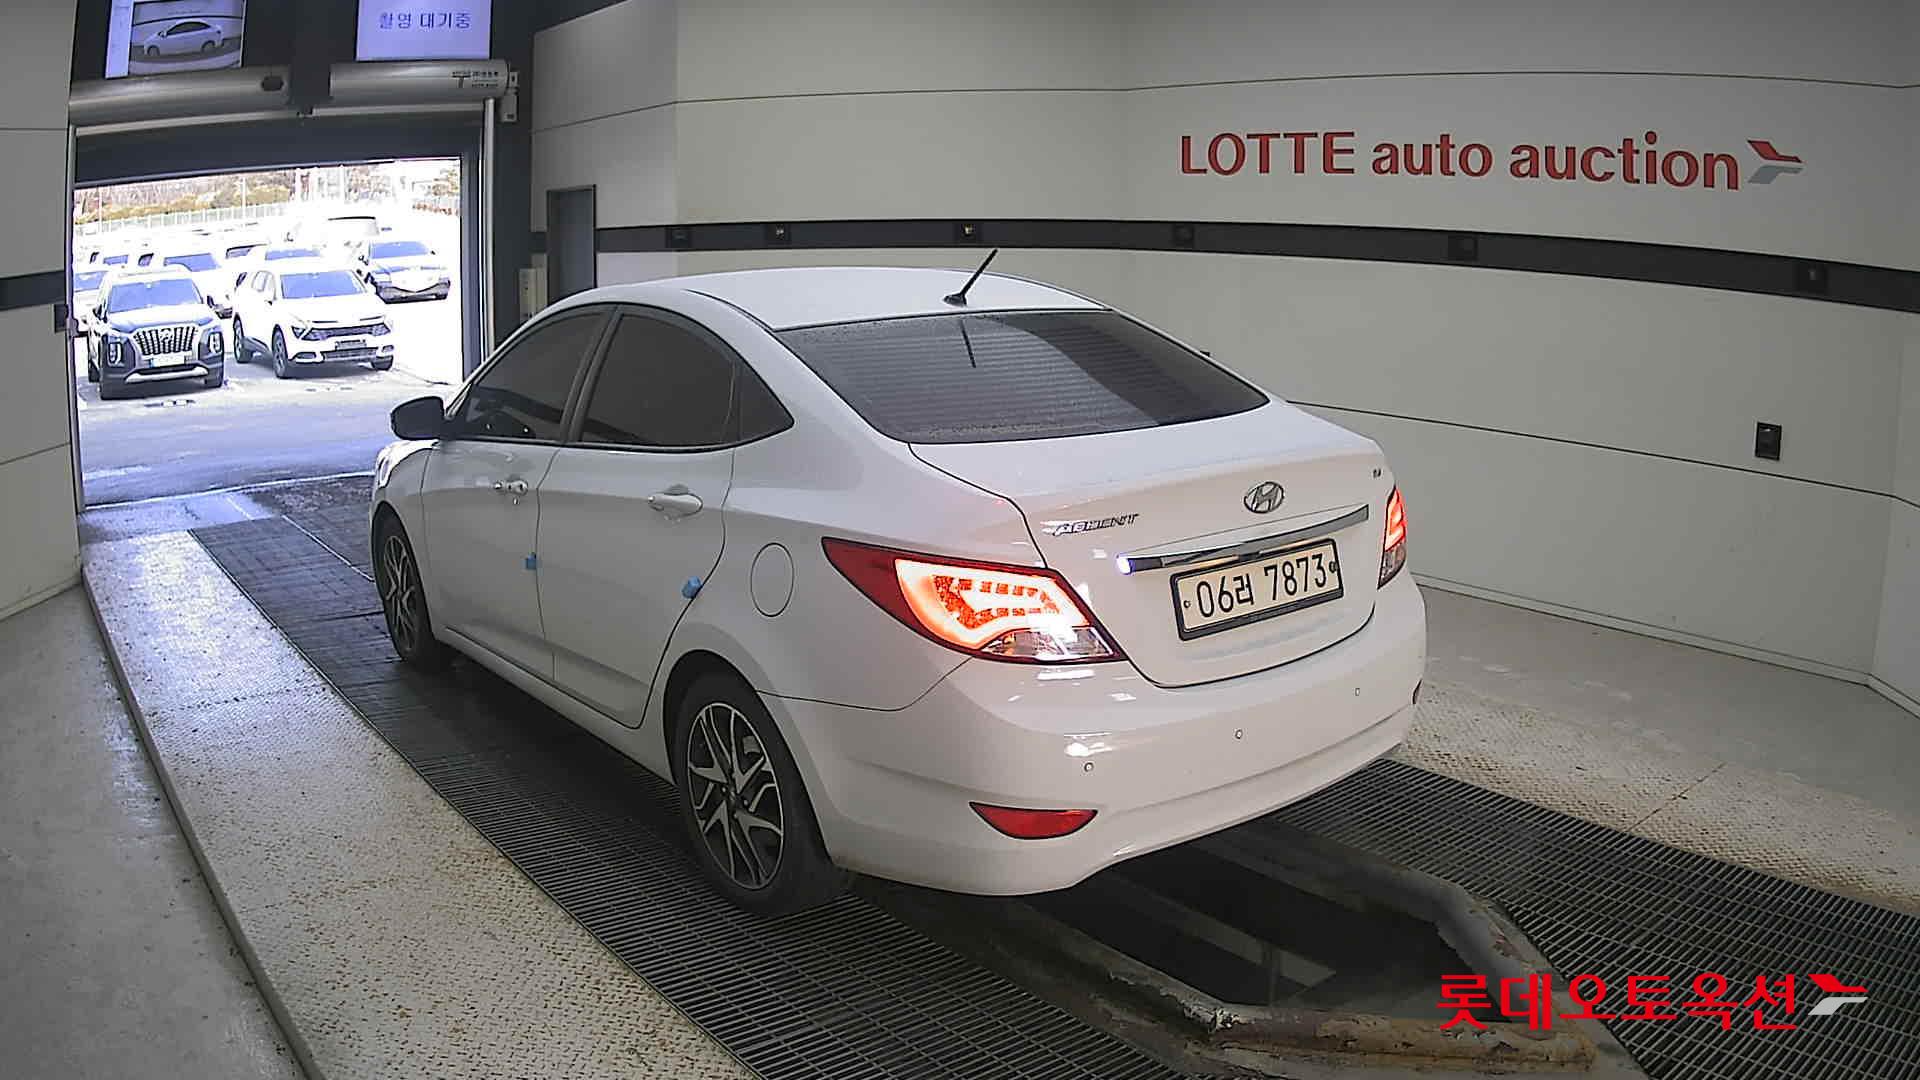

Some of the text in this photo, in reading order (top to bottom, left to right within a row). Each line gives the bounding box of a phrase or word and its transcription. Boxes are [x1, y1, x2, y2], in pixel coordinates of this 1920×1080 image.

[419, 12, 471, 29] 대기중
[1181, 131, 1740, 190] LOTTE auto auction
[1196, 552, 1327, 618] 06러 7873
